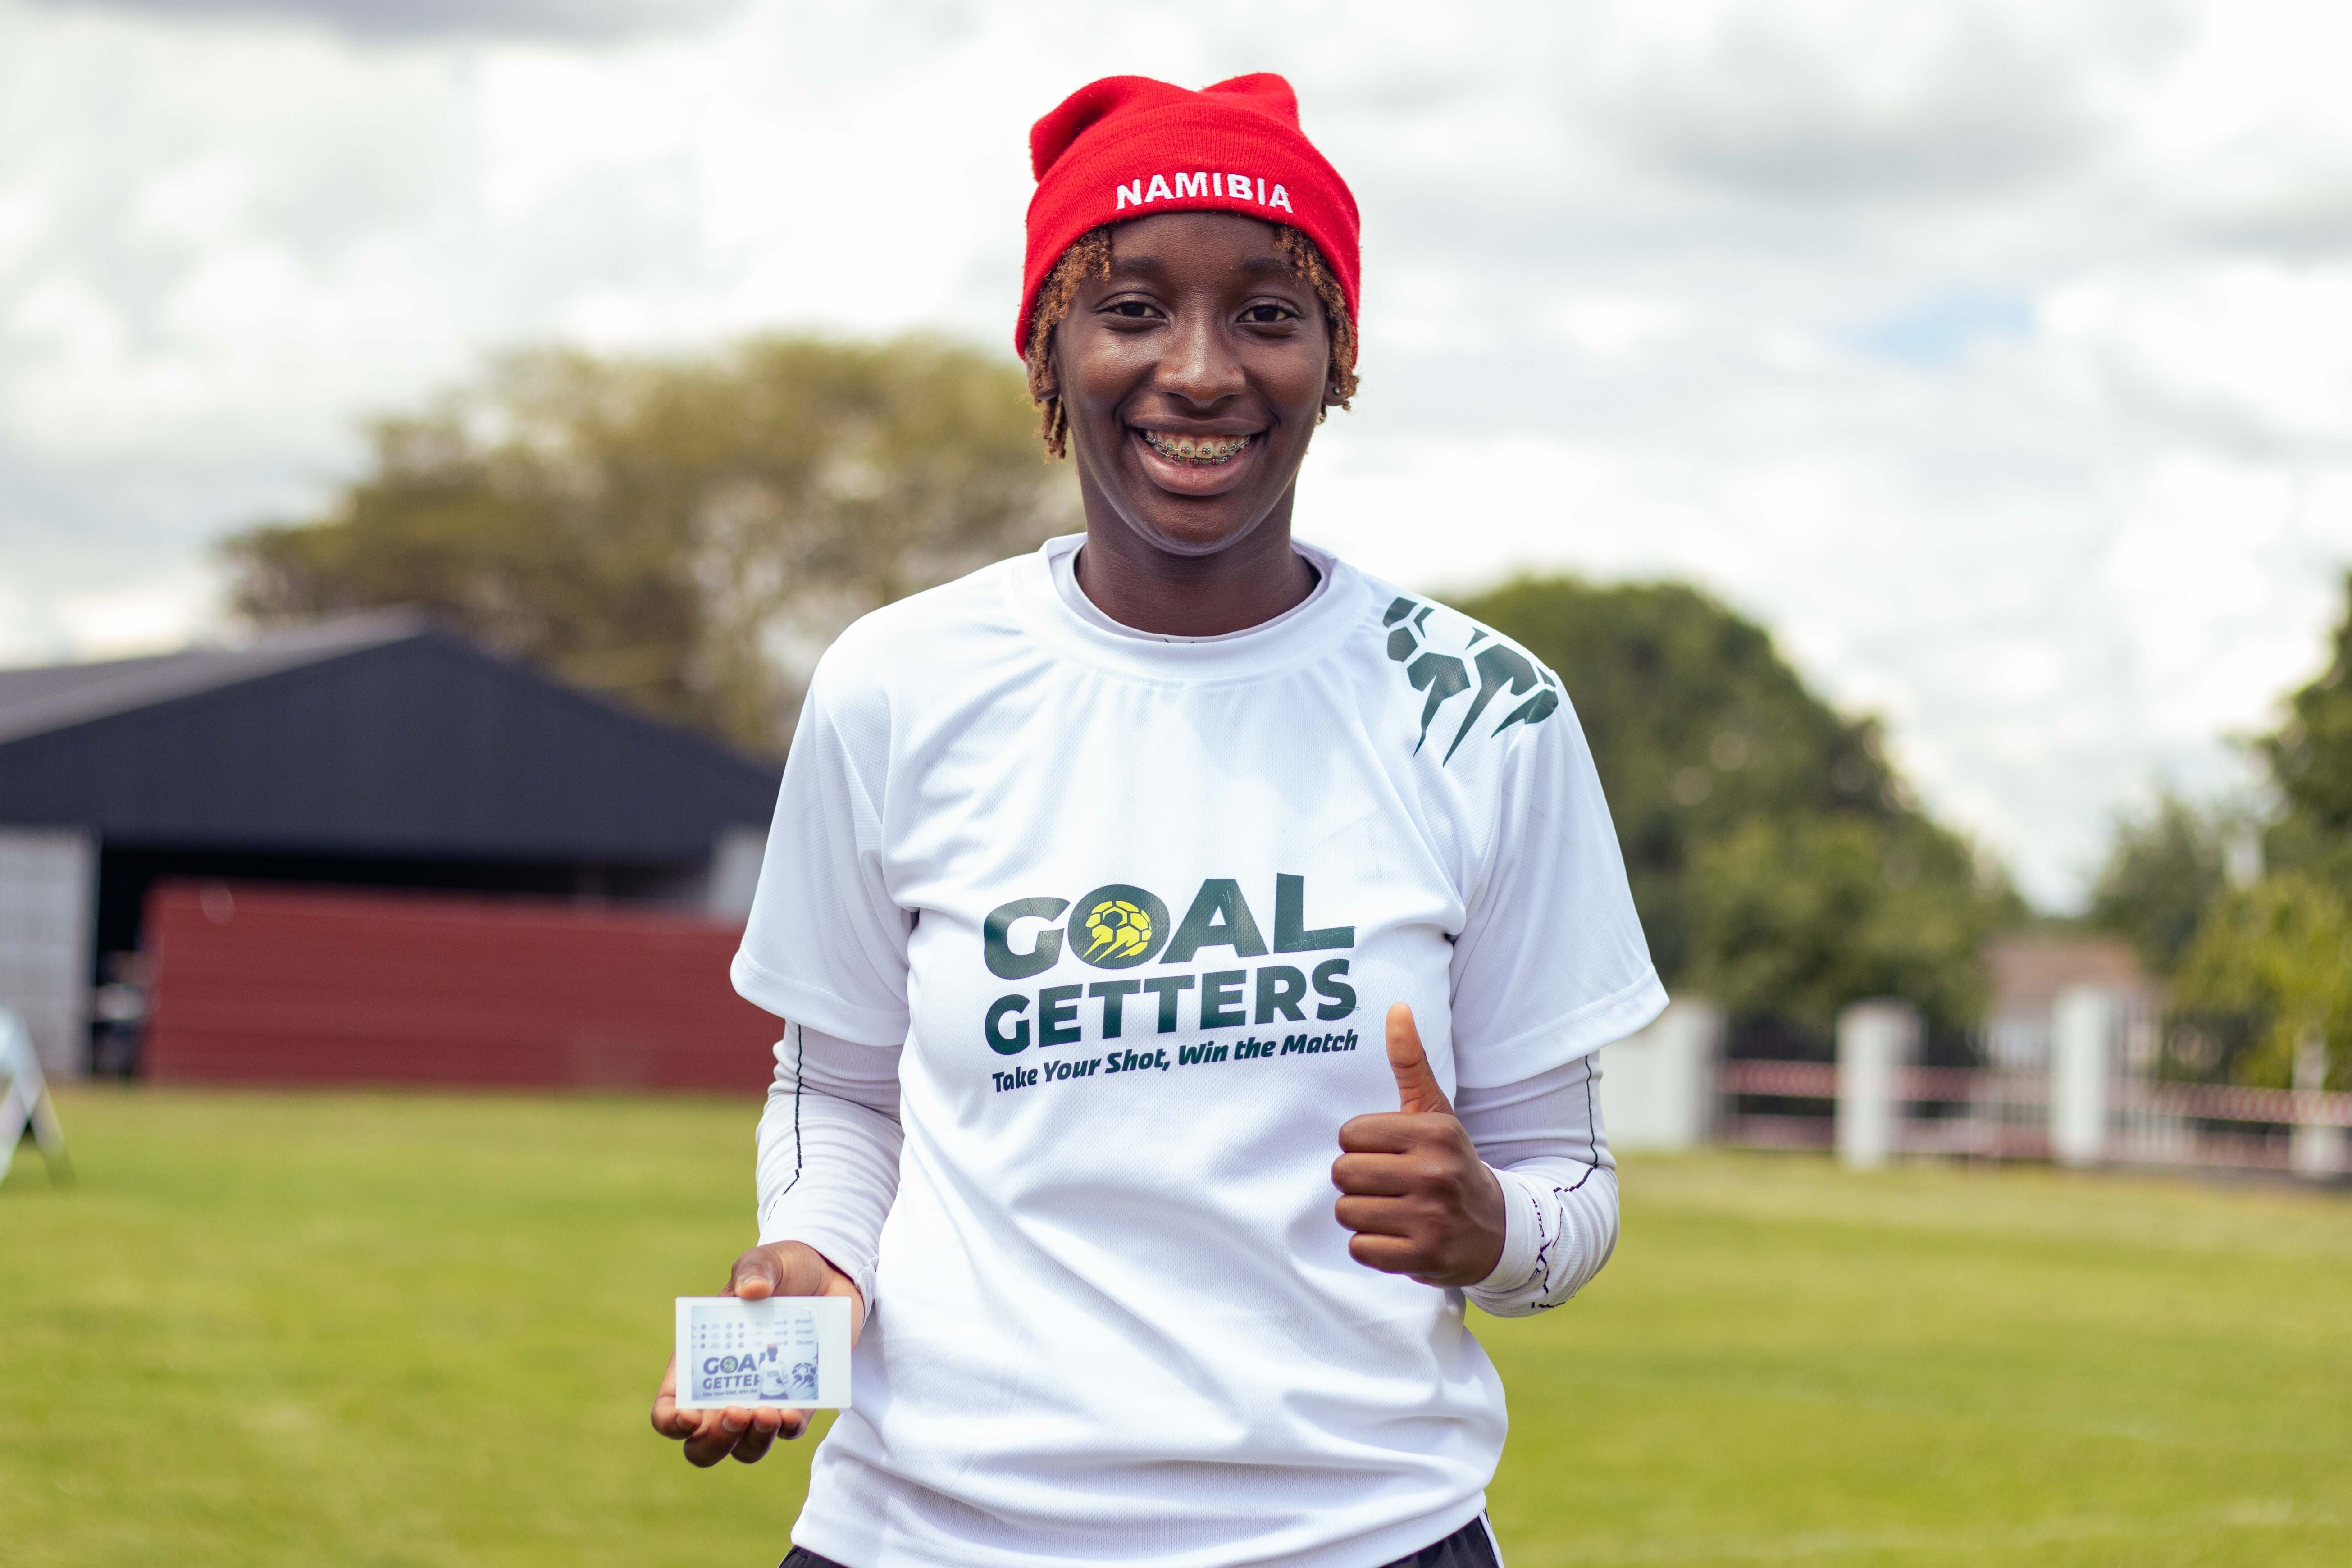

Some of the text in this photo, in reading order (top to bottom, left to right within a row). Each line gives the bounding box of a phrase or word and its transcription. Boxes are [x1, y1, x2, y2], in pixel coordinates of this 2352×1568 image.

[1116, 172, 1293, 213] NAMIBIA
[983, 873, 1354, 980] GOAL
[984, 958, 1357, 1055] GETTERS
[992, 1029, 1358, 1092] Take Your Shot, Win the Match
